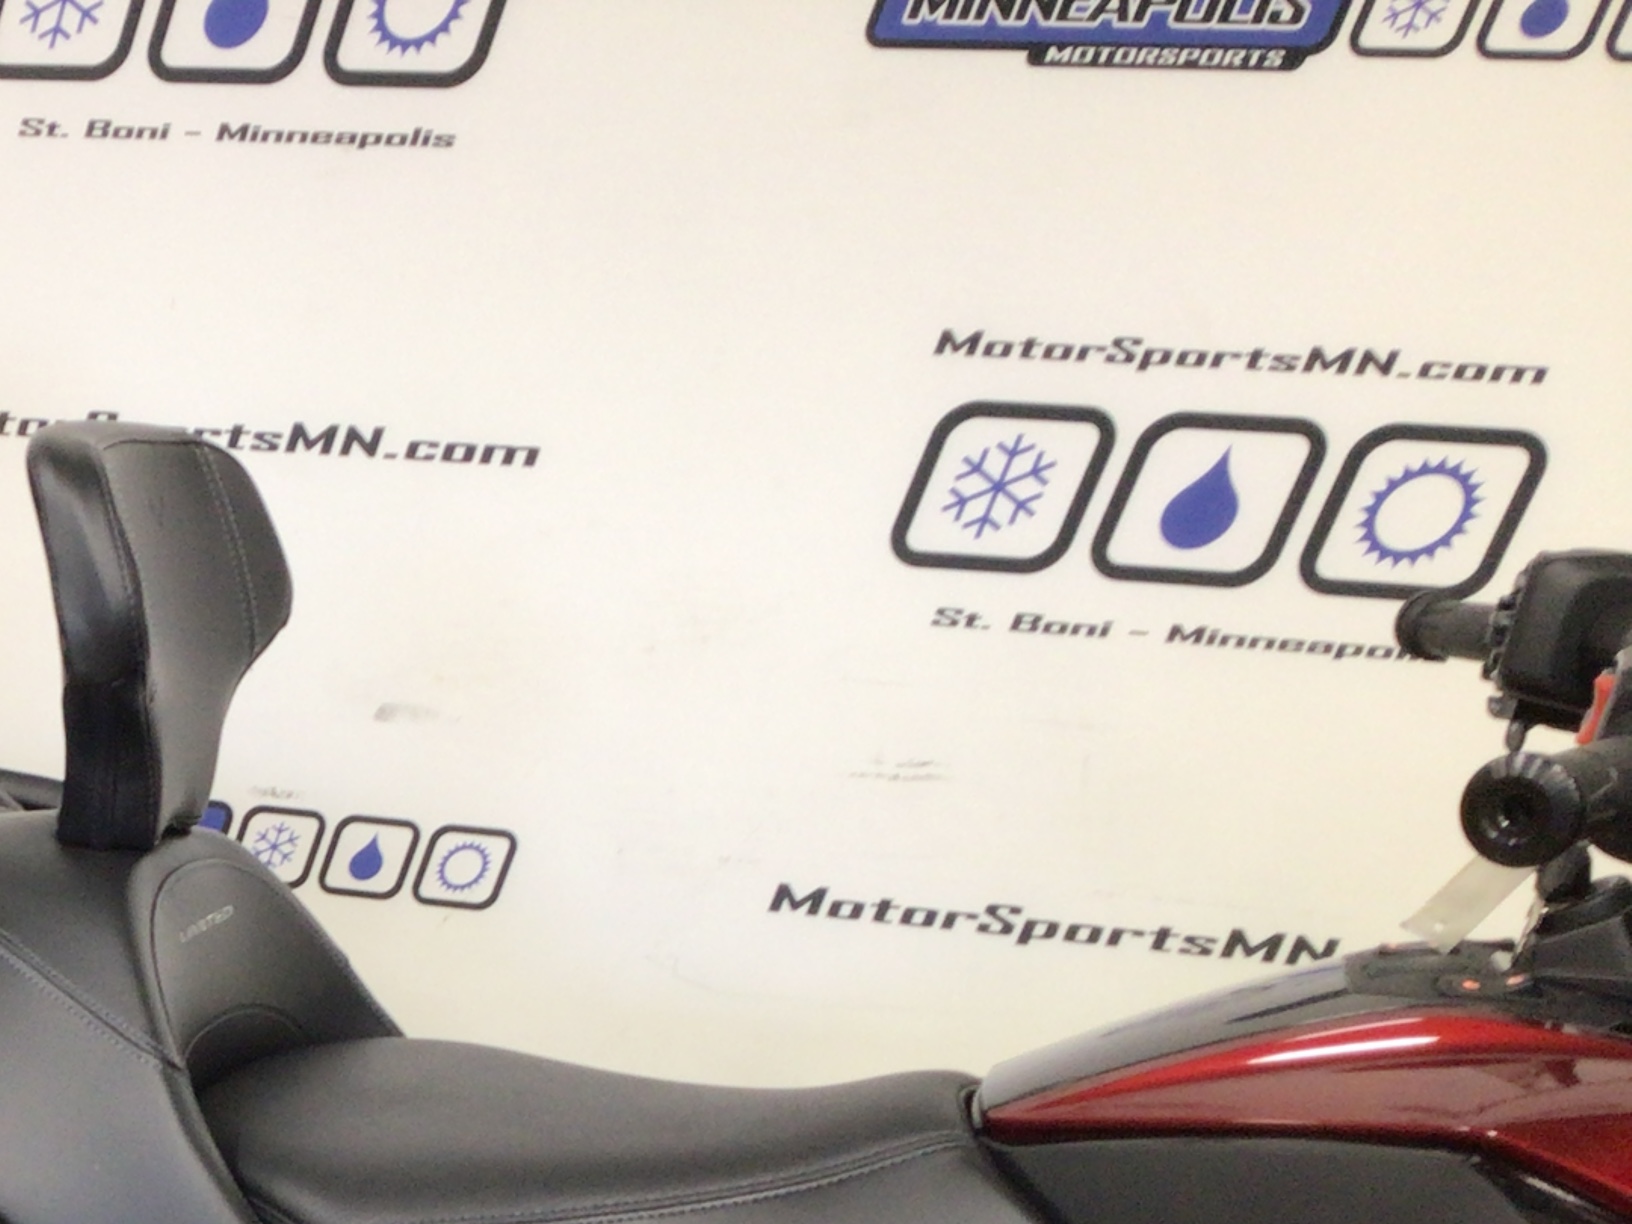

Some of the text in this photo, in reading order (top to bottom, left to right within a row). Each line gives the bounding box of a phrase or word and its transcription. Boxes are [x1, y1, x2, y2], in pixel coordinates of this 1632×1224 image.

[1043, 44, 1287, 70] MOTORSPORTS
[18, 116, 70, 140] St.
[84, 118, 171, 141] Boni
[214, 121, 457, 150] Minneapolis
[932, 327, 1551, 387] MotorSportsMN.com
[930, 606, 991, 632] St.
[1008, 611, 1114, 639] Boni
[1164, 622, 1428, 662] Minneapo
